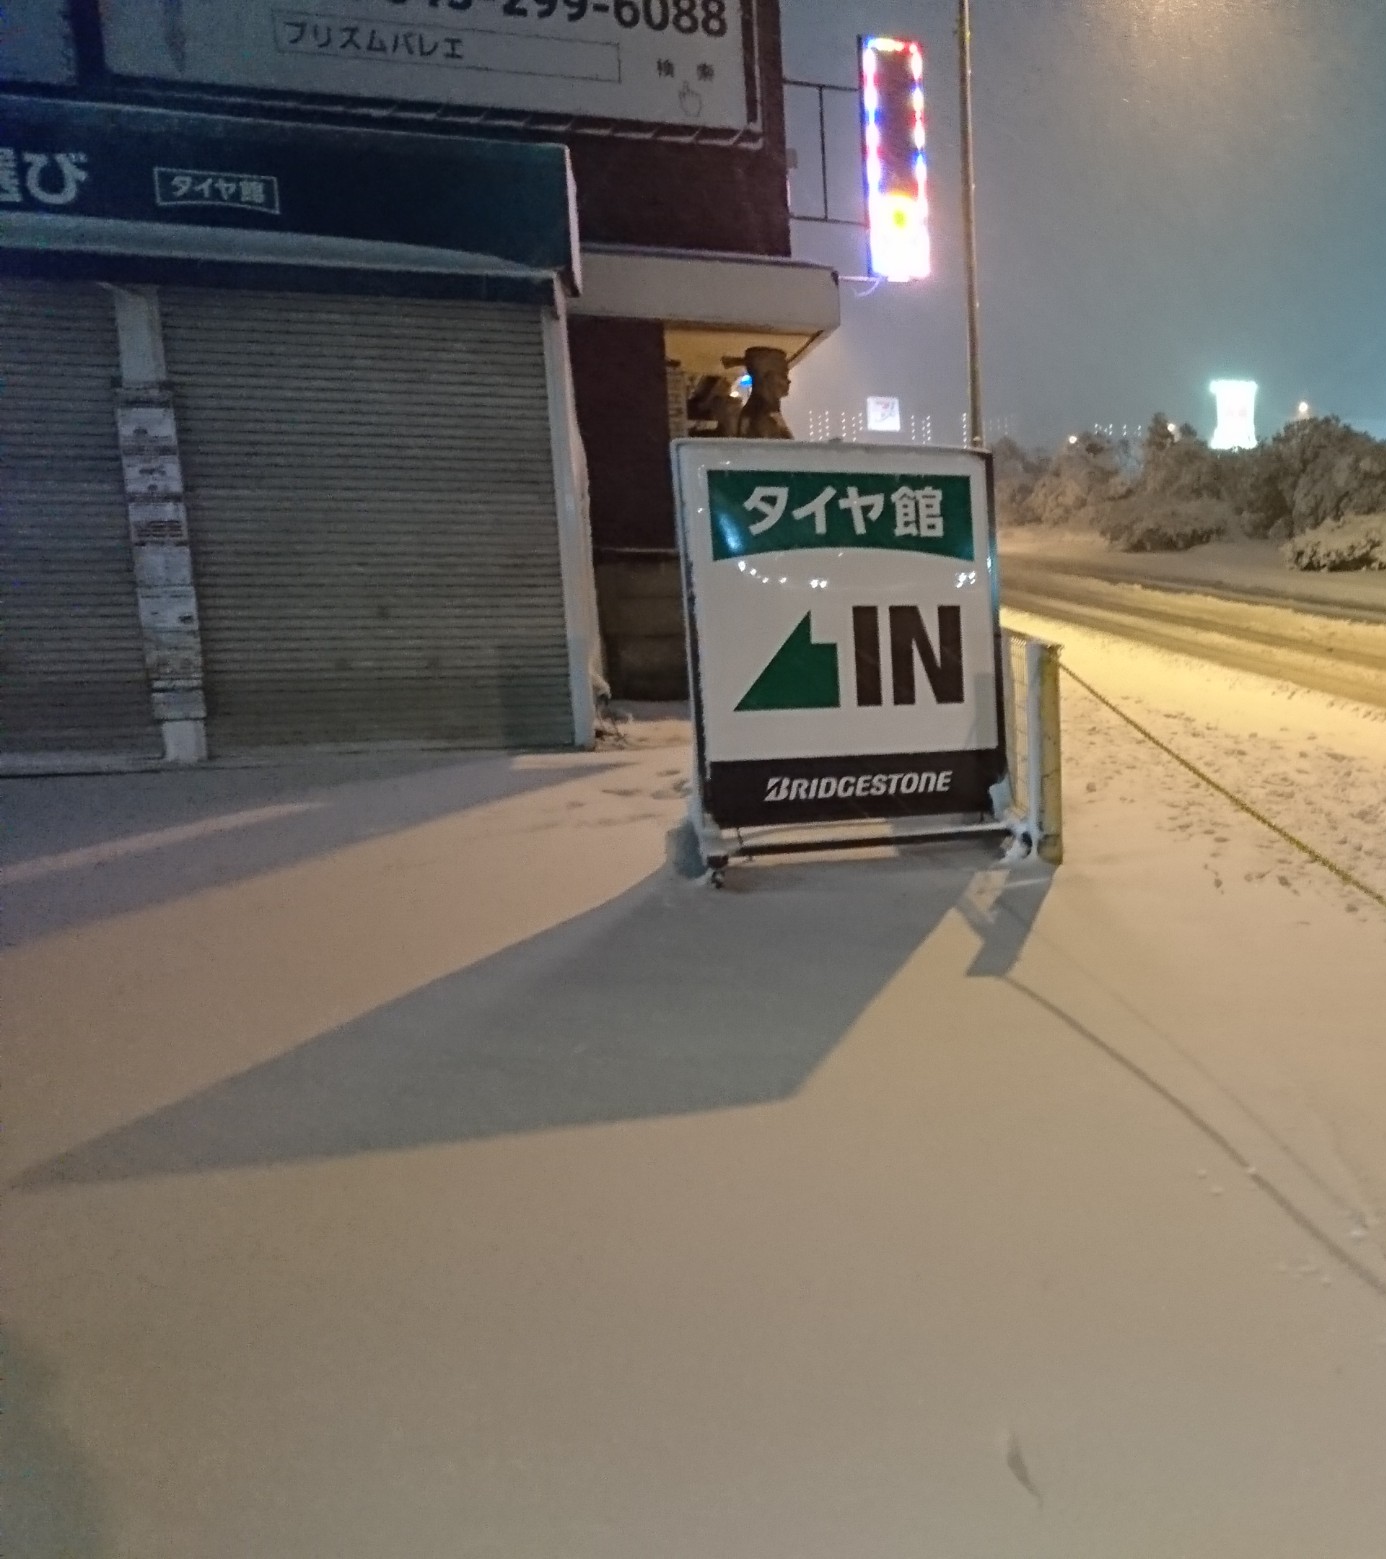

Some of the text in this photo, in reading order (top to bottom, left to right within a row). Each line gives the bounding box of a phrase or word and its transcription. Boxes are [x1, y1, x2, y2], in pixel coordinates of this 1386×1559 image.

[170, 175, 265, 204] タイヤ館
[743, 485, 944, 538] タイヤ館
[852, 604, 965, 707] IN
[763, 770, 953, 802] BRIDGESTONE
